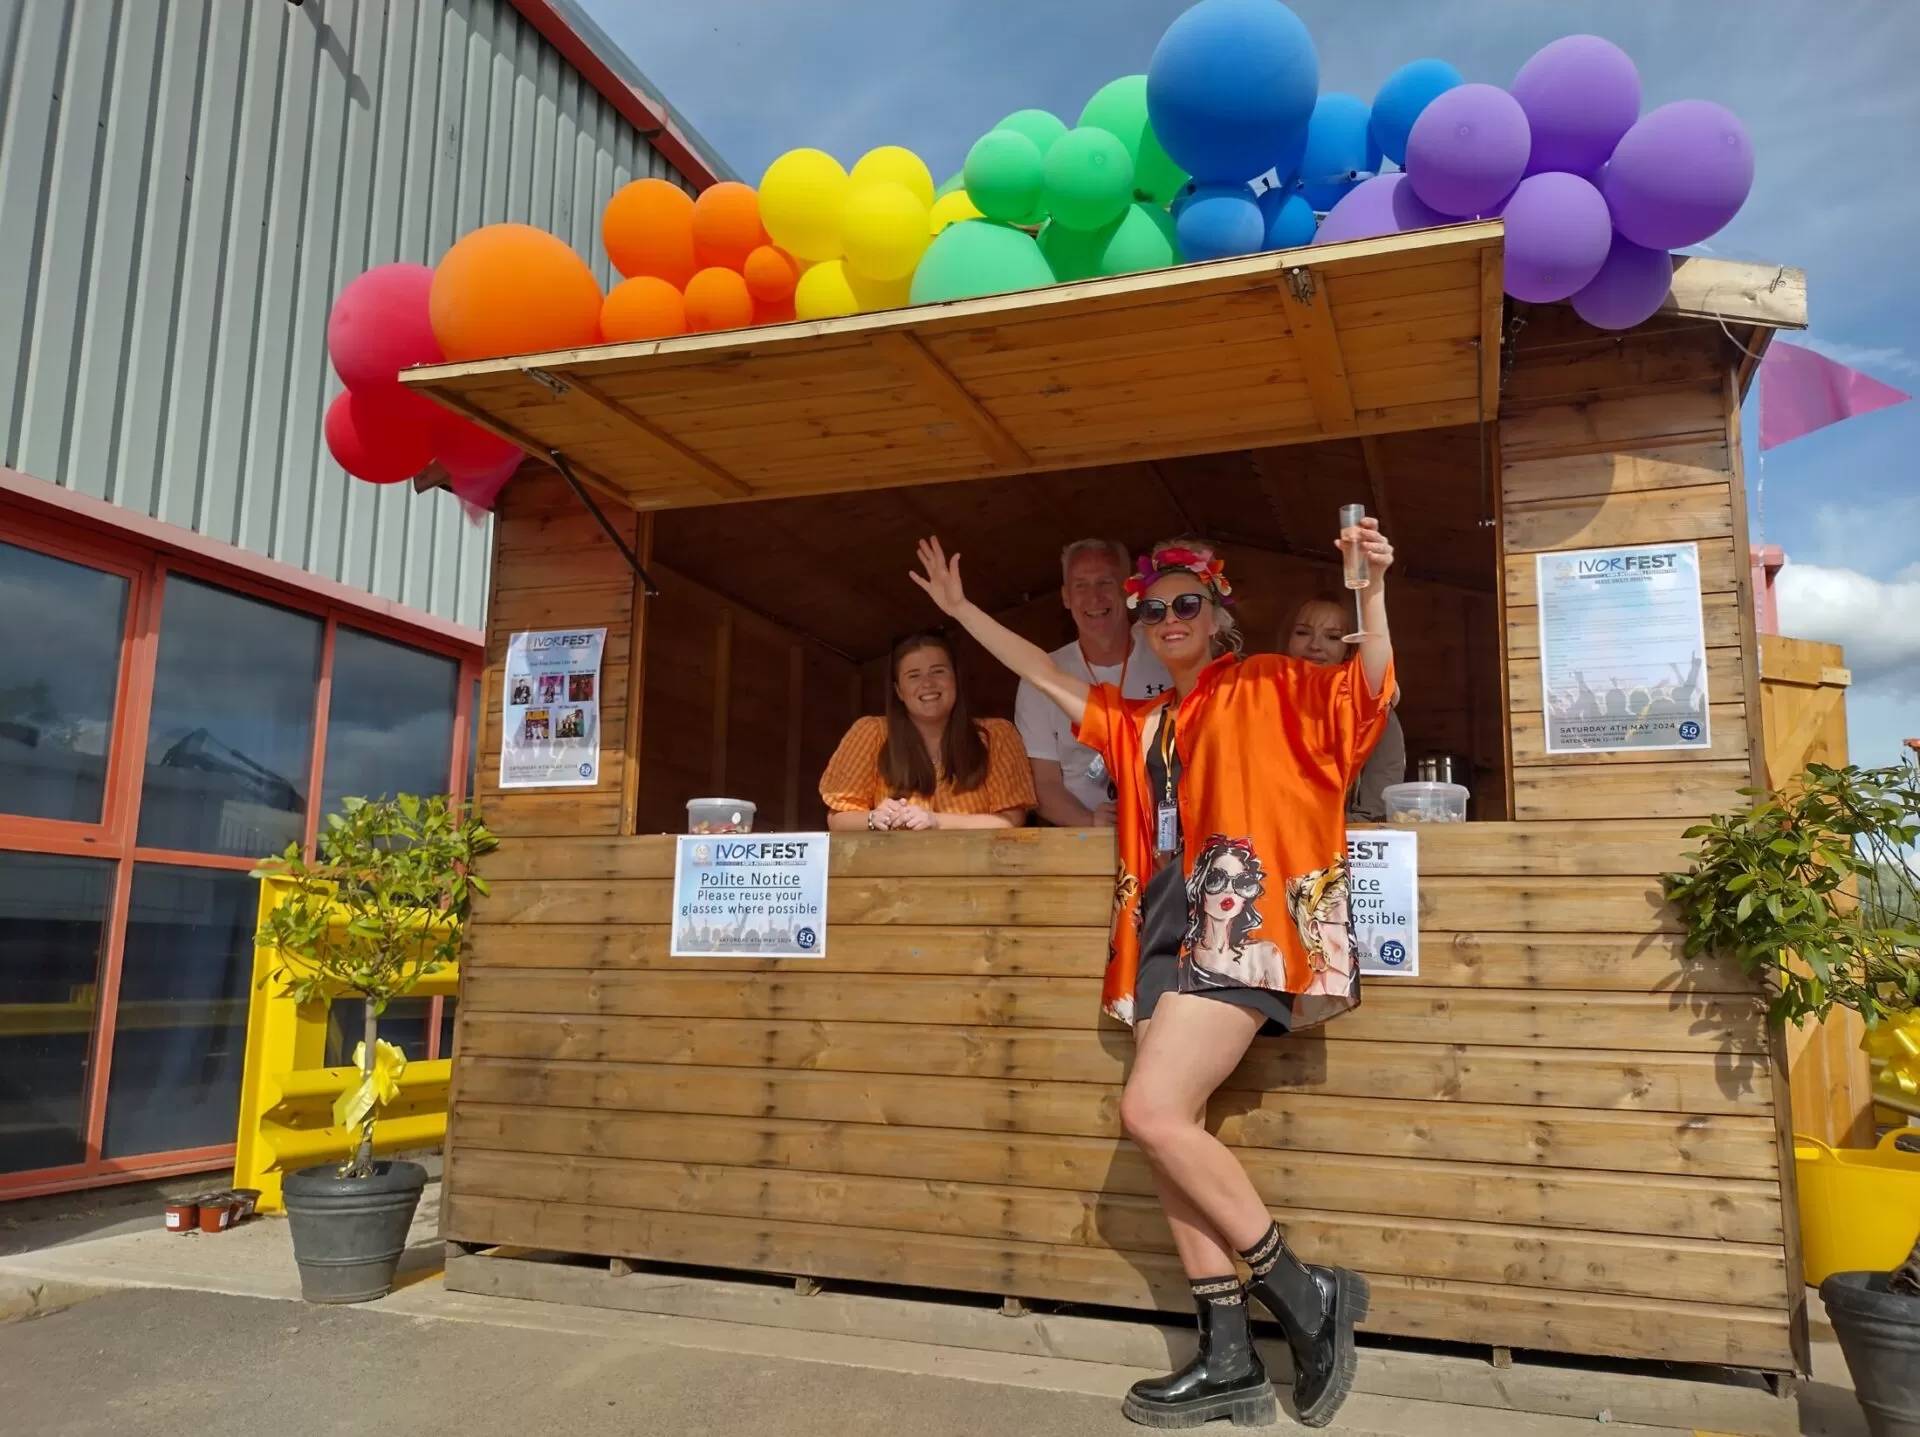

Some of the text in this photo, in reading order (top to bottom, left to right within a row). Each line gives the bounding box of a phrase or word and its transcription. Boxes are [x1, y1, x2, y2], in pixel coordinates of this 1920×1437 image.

[1578, 553, 1677, 573] IVORFEST
[534, 634, 594, 647] IVORFEST
[1560, 722, 1676, 734] SATURDAY 4TH MAY 2024
[1682, 727, 1697, 735] 50
[716, 842, 808, 859] IVORFEST
[701, 872, 800, 886] Polite Notice
[1352, 875, 1380, 891] ice
[697, 890, 803, 903] Please reuse your
[681, 903, 817, 916] glasses where possible
[1352, 912, 1406, 925] ossible
[800, 933, 814, 942] 50
[1383, 946, 1402, 959] 50
